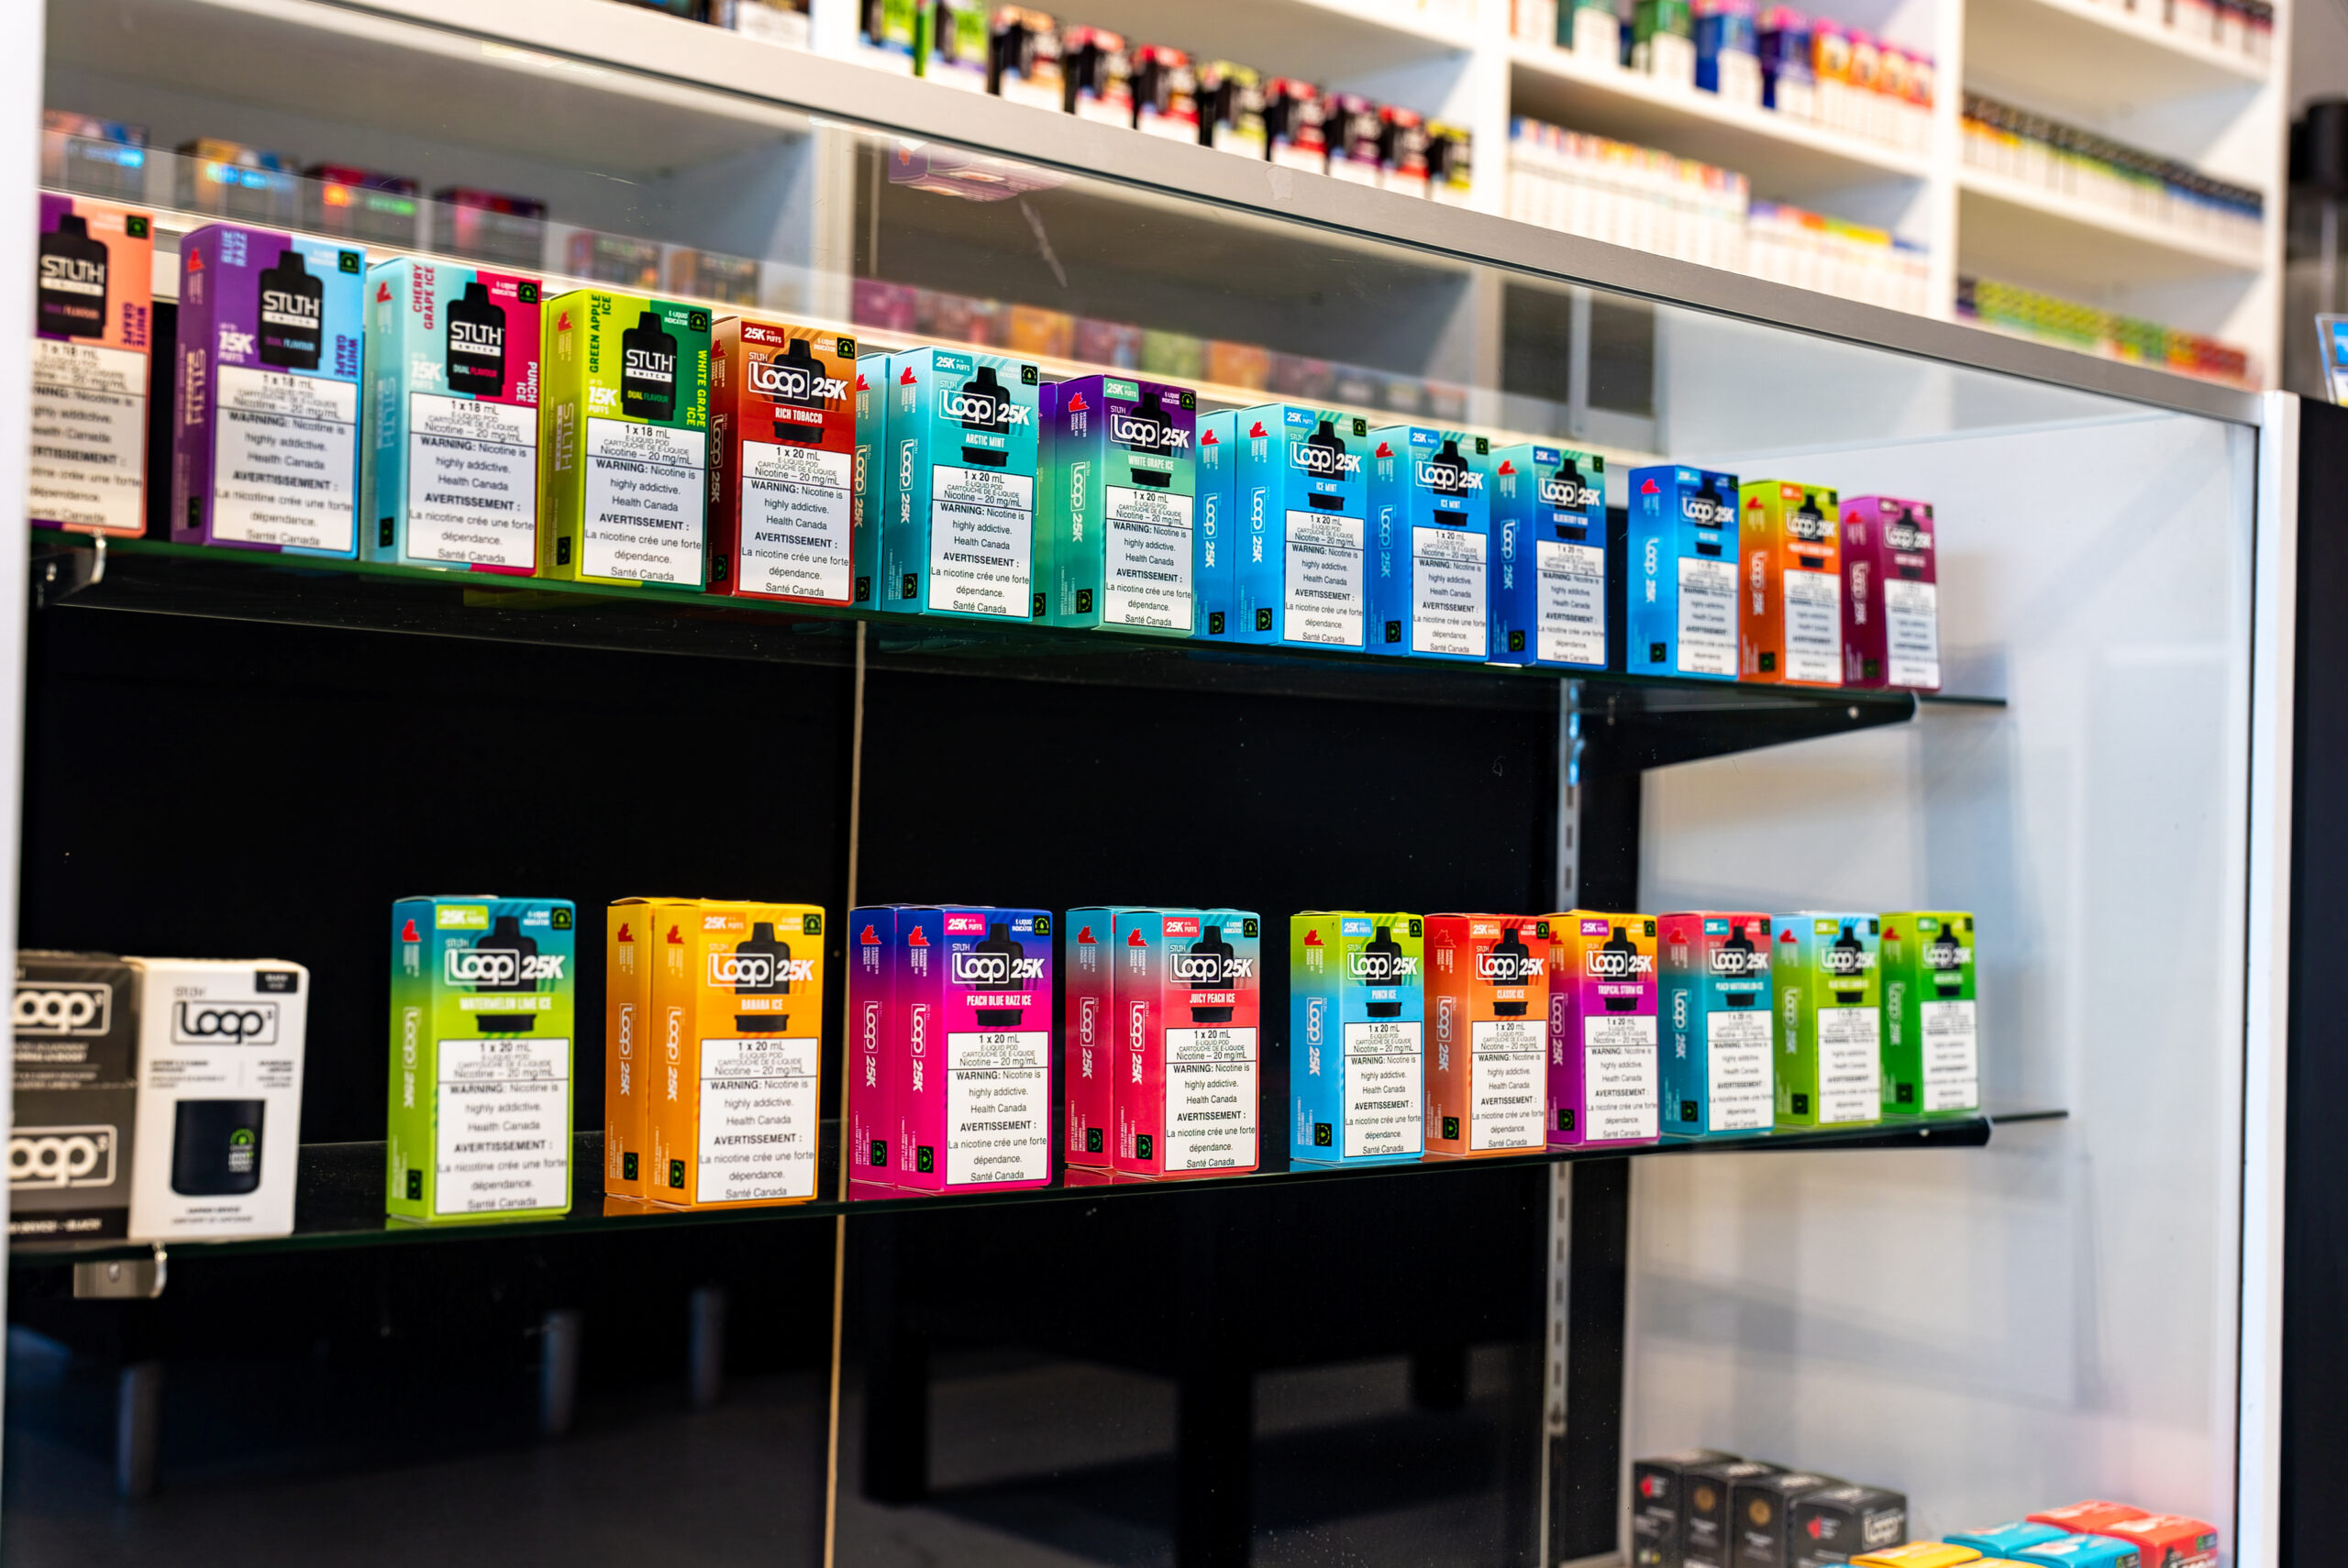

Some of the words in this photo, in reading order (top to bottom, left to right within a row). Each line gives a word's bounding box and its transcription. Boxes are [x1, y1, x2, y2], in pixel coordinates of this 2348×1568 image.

[40, 255, 105, 283] STLTH
[425, 266, 435, 284] ICE
[413, 263, 423, 314] CHERRY
[262, 289, 320, 318] STLTH
[424, 287, 435, 330] GRAPE
[602, 295, 612, 315] ICE
[591, 294, 601, 335] APPLE
[450, 321, 502, 347] STLTH
[743, 326, 767, 341] 25K
[766, 334, 782, 344] PUFFS
[590, 336, 600, 373] GREEN
[625, 348, 673, 372] STLTH
[748, 351, 769, 362] STLTH
[936, 356, 957, 370] 25K
[410, 359, 443, 382] 15K
[632, 370, 667, 381] SWITCH
[696, 350, 707, 387] WHITE
[515, 381, 526, 402] ICE
[526, 360, 537, 403] PUNCH
[749, 361, 808, 400] Loop
[811, 376, 848, 402] 25K
[939, 380, 958, 390] STLTH
[588, 387, 617, 407] 15K
[627, 391, 644, 401] DUAL
[643, 391, 670, 404] FLAVOUR
[588, 404, 610, 415] PUFFS
[686, 406, 696, 426] ICE
[695, 388, 706, 428] GRAPE
[775, 406, 792, 420] RICH
[792, 408, 823, 425] TOBACCO
[940, 390, 994, 425] Loop
[996, 403, 1032, 426] 25K
[1110, 404, 1126, 414] STLTH
[965, 432, 988, 447] ARCTIC
[989, 436, 1005, 449] MINT
[1112, 414, 1158, 447] Loop
[1160, 427, 1191, 449] 25K
[1127, 454, 1146, 469] WHITE
[1146, 457, 1166, 470] GRAPE
[1165, 459, 1175, 471] ICE
[1291, 442, 1334, 474] Loop
[1335, 453, 1362, 473] 25K
[595, 458, 648, 473] WARNING:
[650, 465, 685, 478] Nicotine
[688, 469, 696, 479] is
[1417, 461, 1457, 491] Loop
[1458, 473, 1484, 491] 25K
[610, 477, 637, 491] highly
[639, 480, 681, 494] addictive.
[1324, 482, 1337, 493] MINT
[1539, 478, 1577, 507] Loop
[1577, 488, 1601, 507] 25K
[900, 492, 911, 525] 25K
[1440, 499, 1448, 508] ICE
[1447, 499, 1461, 510] MINT
[1071, 513, 1084, 543] 25K
[754, 530, 832, 547] AVERTISSEMENT
[740, 546, 752, 556] La
[755, 547, 789, 559] nicotine
[791, 550, 810, 561] crée
[812, 555, 827, 564] une
[829, 555, 848, 566] forte
[768, 565, 822, 581] dépendance.
[764, 580, 790, 593] Santé
[791, 583, 824, 596] Canada
[947, 917, 969, 931] 25K
[968, 922, 982, 931] PUFFS
[1166, 921, 1184, 933] 25K
[1184, 925, 1198, 933] PUFFS
[952, 943, 970, 952] STLTH
[1169, 944, 1186, 953] STLTH
[446, 949, 517, 985] Loop
[520, 955, 566, 980] 25K
[710, 954, 772, 987] Loop
[774, 959, 815, 982] 25K
[954, 953, 1007, 984] Loop
[1010, 957, 1046, 980] 25K
[1171, 954, 1220, 983] Loop
[1222, 958, 1254, 978] 25K
[1348, 953, 1390, 980] Loop
[1391, 956, 1418, 976] 25K
[1477, 954, 1517, 979] Loop
[1519, 958, 1545, 977] 25K
[1587, 950, 1627, 977] Loop
[1628, 955, 1653, 974] 25K
[1710, 948, 1745, 975] Loop
[966, 994, 986, 1007] PEACH
[987, 994, 1004, 1006] BLUE
[1004, 994, 1021, 1006] RAZZ
[1021, 994, 1032, 1006] ICE
[1189, 992, 1206, 1005] JUICY
[1207, 992, 1224, 1004] PEACH
[1225, 992, 1235, 1004] ICE
[1386, 989, 1397, 999] ICE
[1496, 988, 1514, 999] CLASSIC
[1515, 989, 1525, 999] ICE
[12, 989, 96, 1035] oop
[740, 999, 770, 1011] BANANA
[771, 998, 783, 1010] ICE
[180, 1001, 264, 1044] Loop
[979, 1034, 983, 1043] 1
[994, 1033, 1004, 1043] 20
[1006, 1033, 1020, 1043] mL
[958, 1057, 991, 1066] Nicotine
[1000, 1056, 1010, 1066] 20
[1012, 1056, 1037, 1067] mg/mL
[1132, 1052, 1143, 1086] 25K
[913, 1059, 924, 1093] 25K
[956, 1070, 1001, 1080] WARNING:
[1002, 1069, 1032, 1079] Nicotine
[1034, 1069, 1041, 1078] is
[968, 1087, 991, 1099] highly
[993, 1086, 1028, 1096] addictive.
[969, 1103, 996, 1113] Health
[997, 1102, 1026, 1112] Canada
